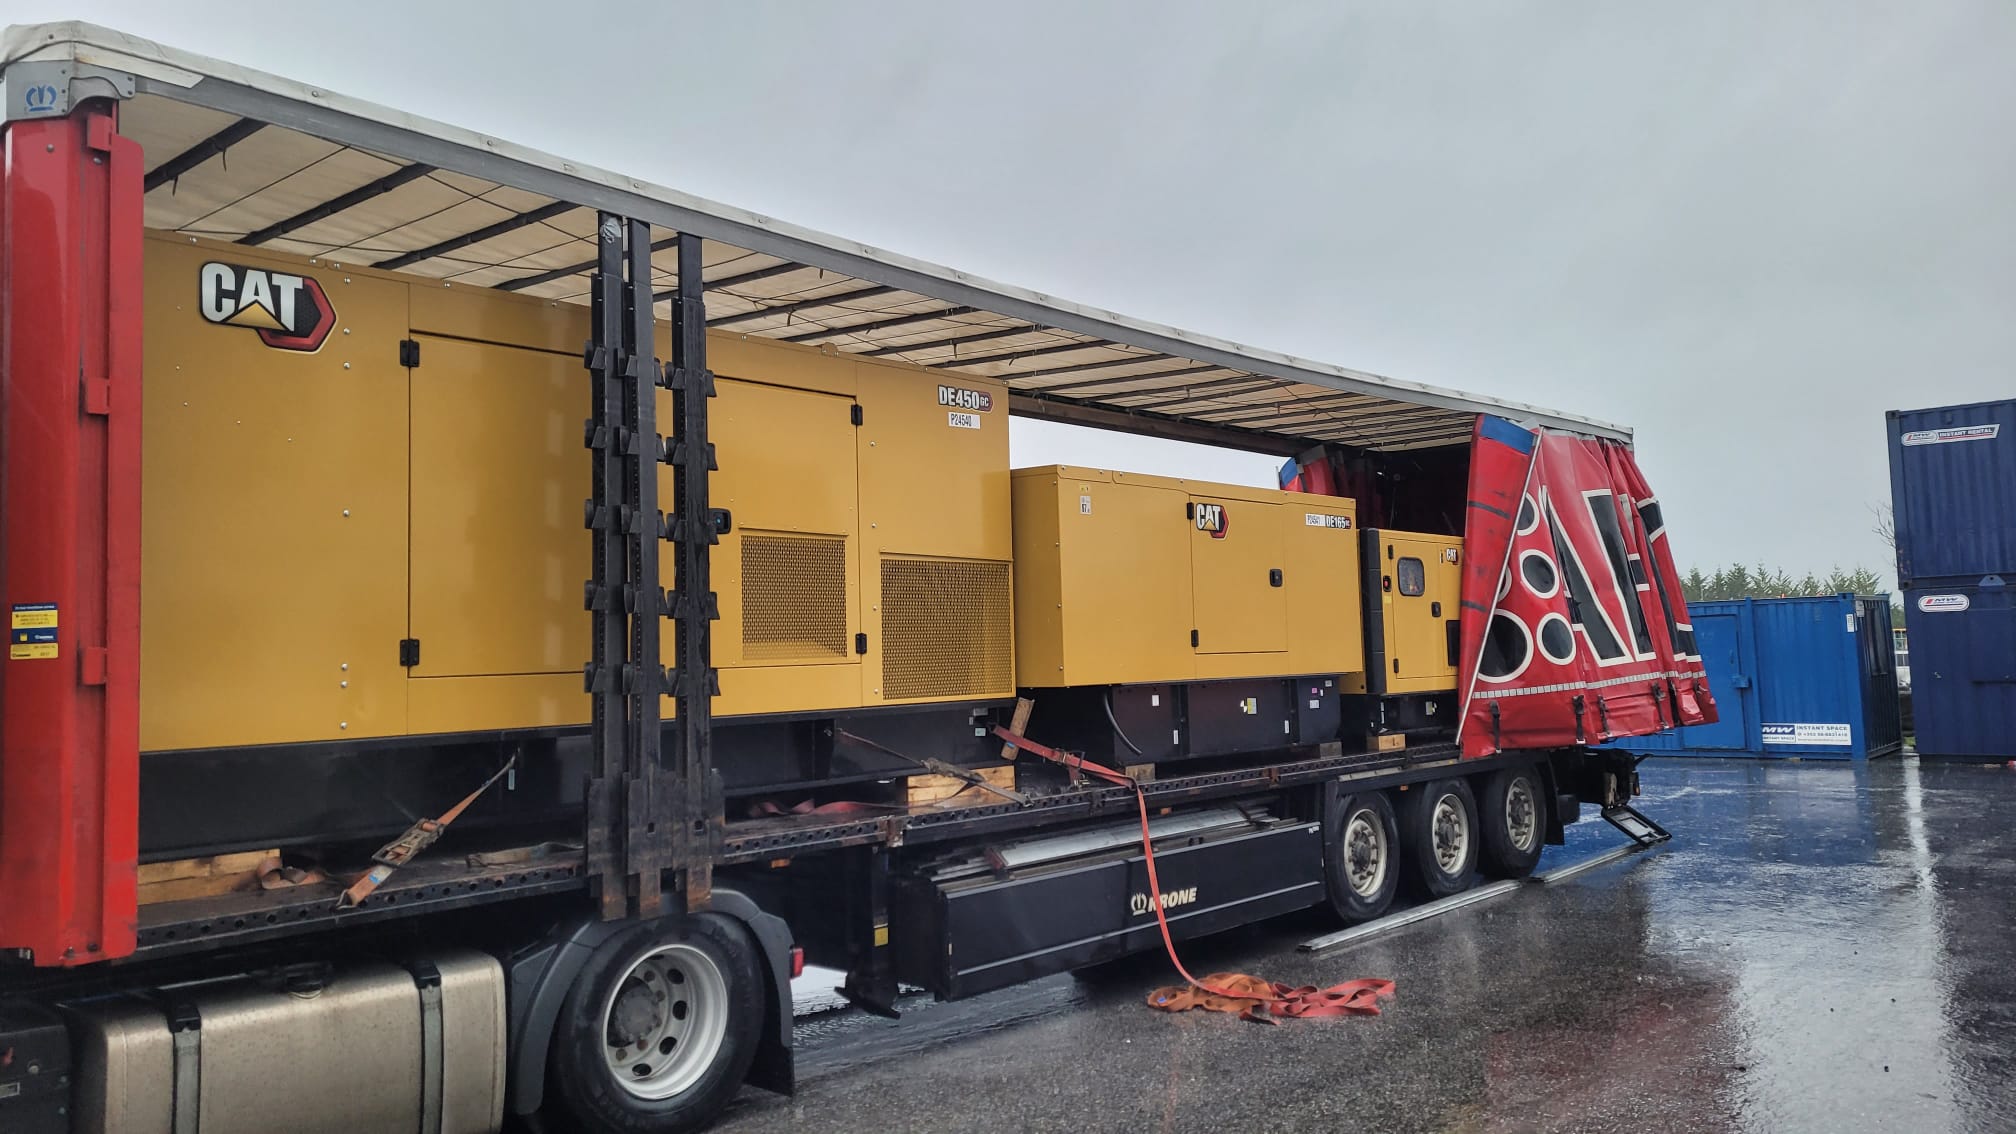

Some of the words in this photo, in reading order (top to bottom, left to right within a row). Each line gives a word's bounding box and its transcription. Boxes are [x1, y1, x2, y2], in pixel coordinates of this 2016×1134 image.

[202, 262, 304, 332] CAT
[938, 385, 979, 410] DE450
[1196, 504, 1221, 531] CAT
[1762, 726, 1794, 734] MW
